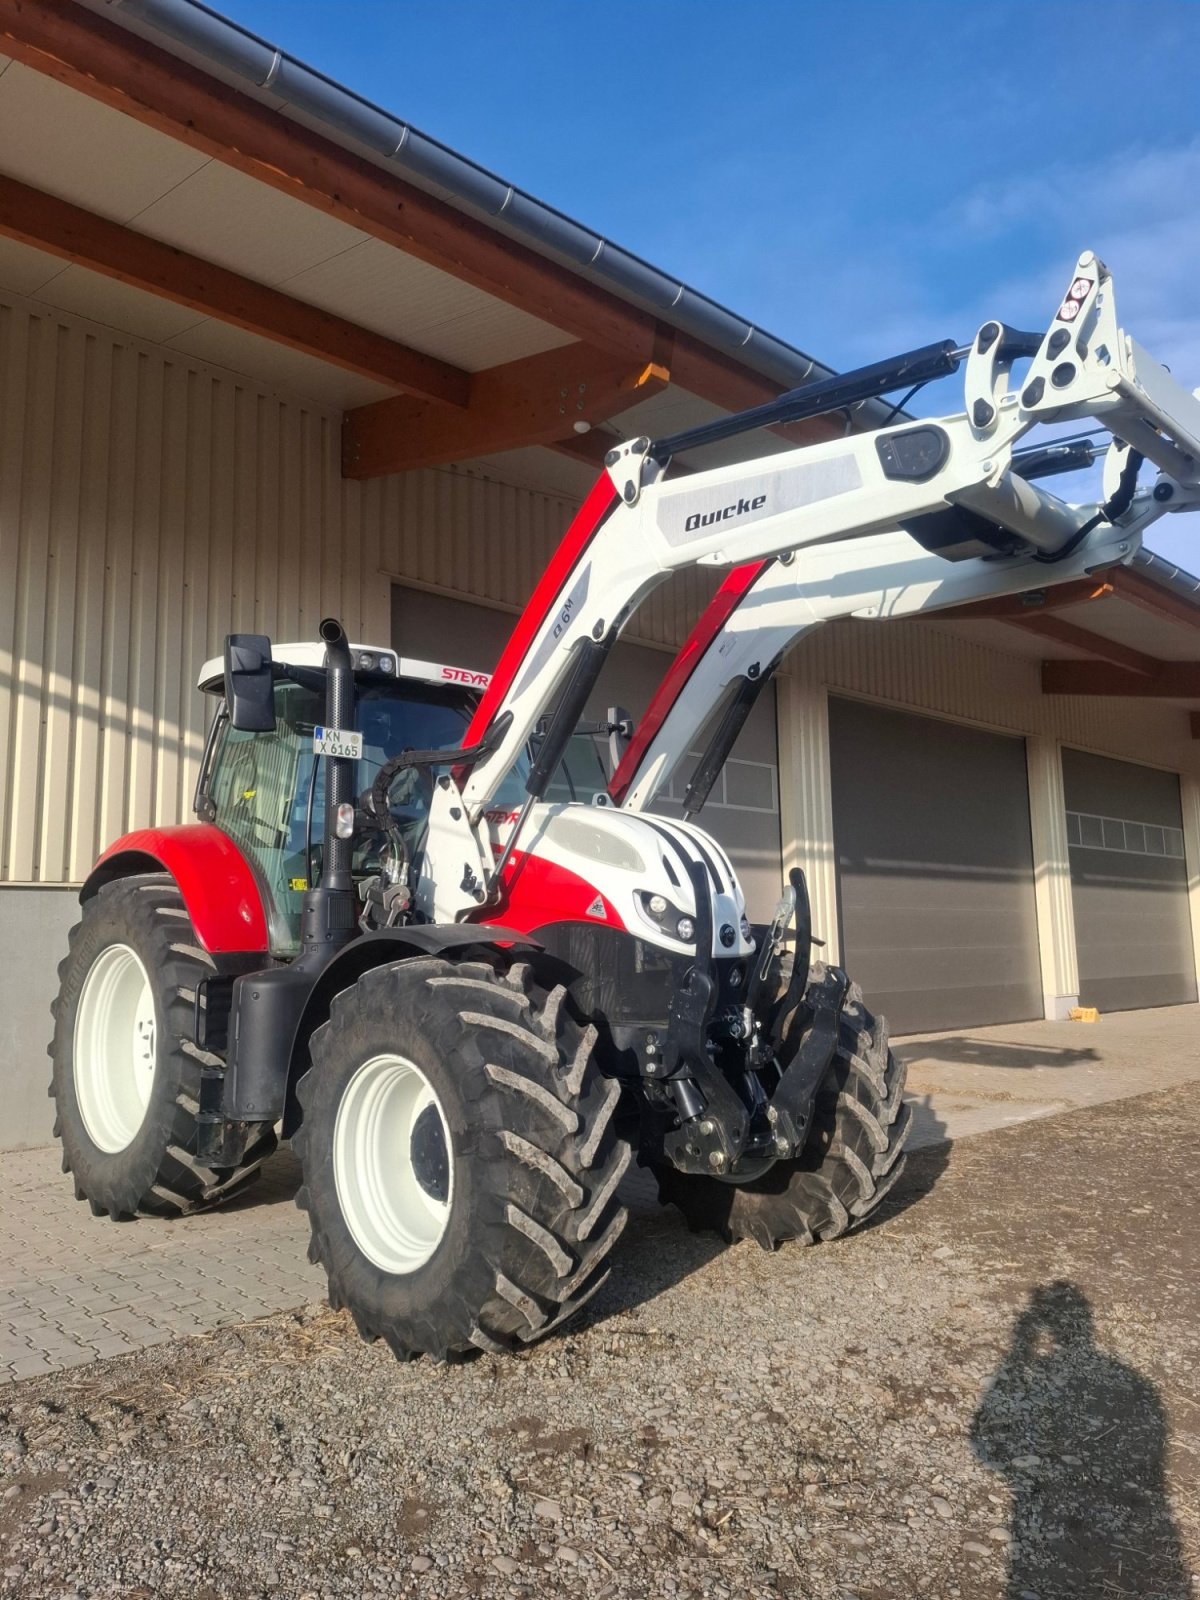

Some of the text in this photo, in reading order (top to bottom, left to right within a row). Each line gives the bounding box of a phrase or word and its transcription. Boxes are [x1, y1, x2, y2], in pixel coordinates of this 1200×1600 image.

[685, 495, 766, 532] Quicke
[441, 668, 489, 687] STEYR
[325, 730, 340, 743] KN
[320, 742, 358, 757] X 6165
